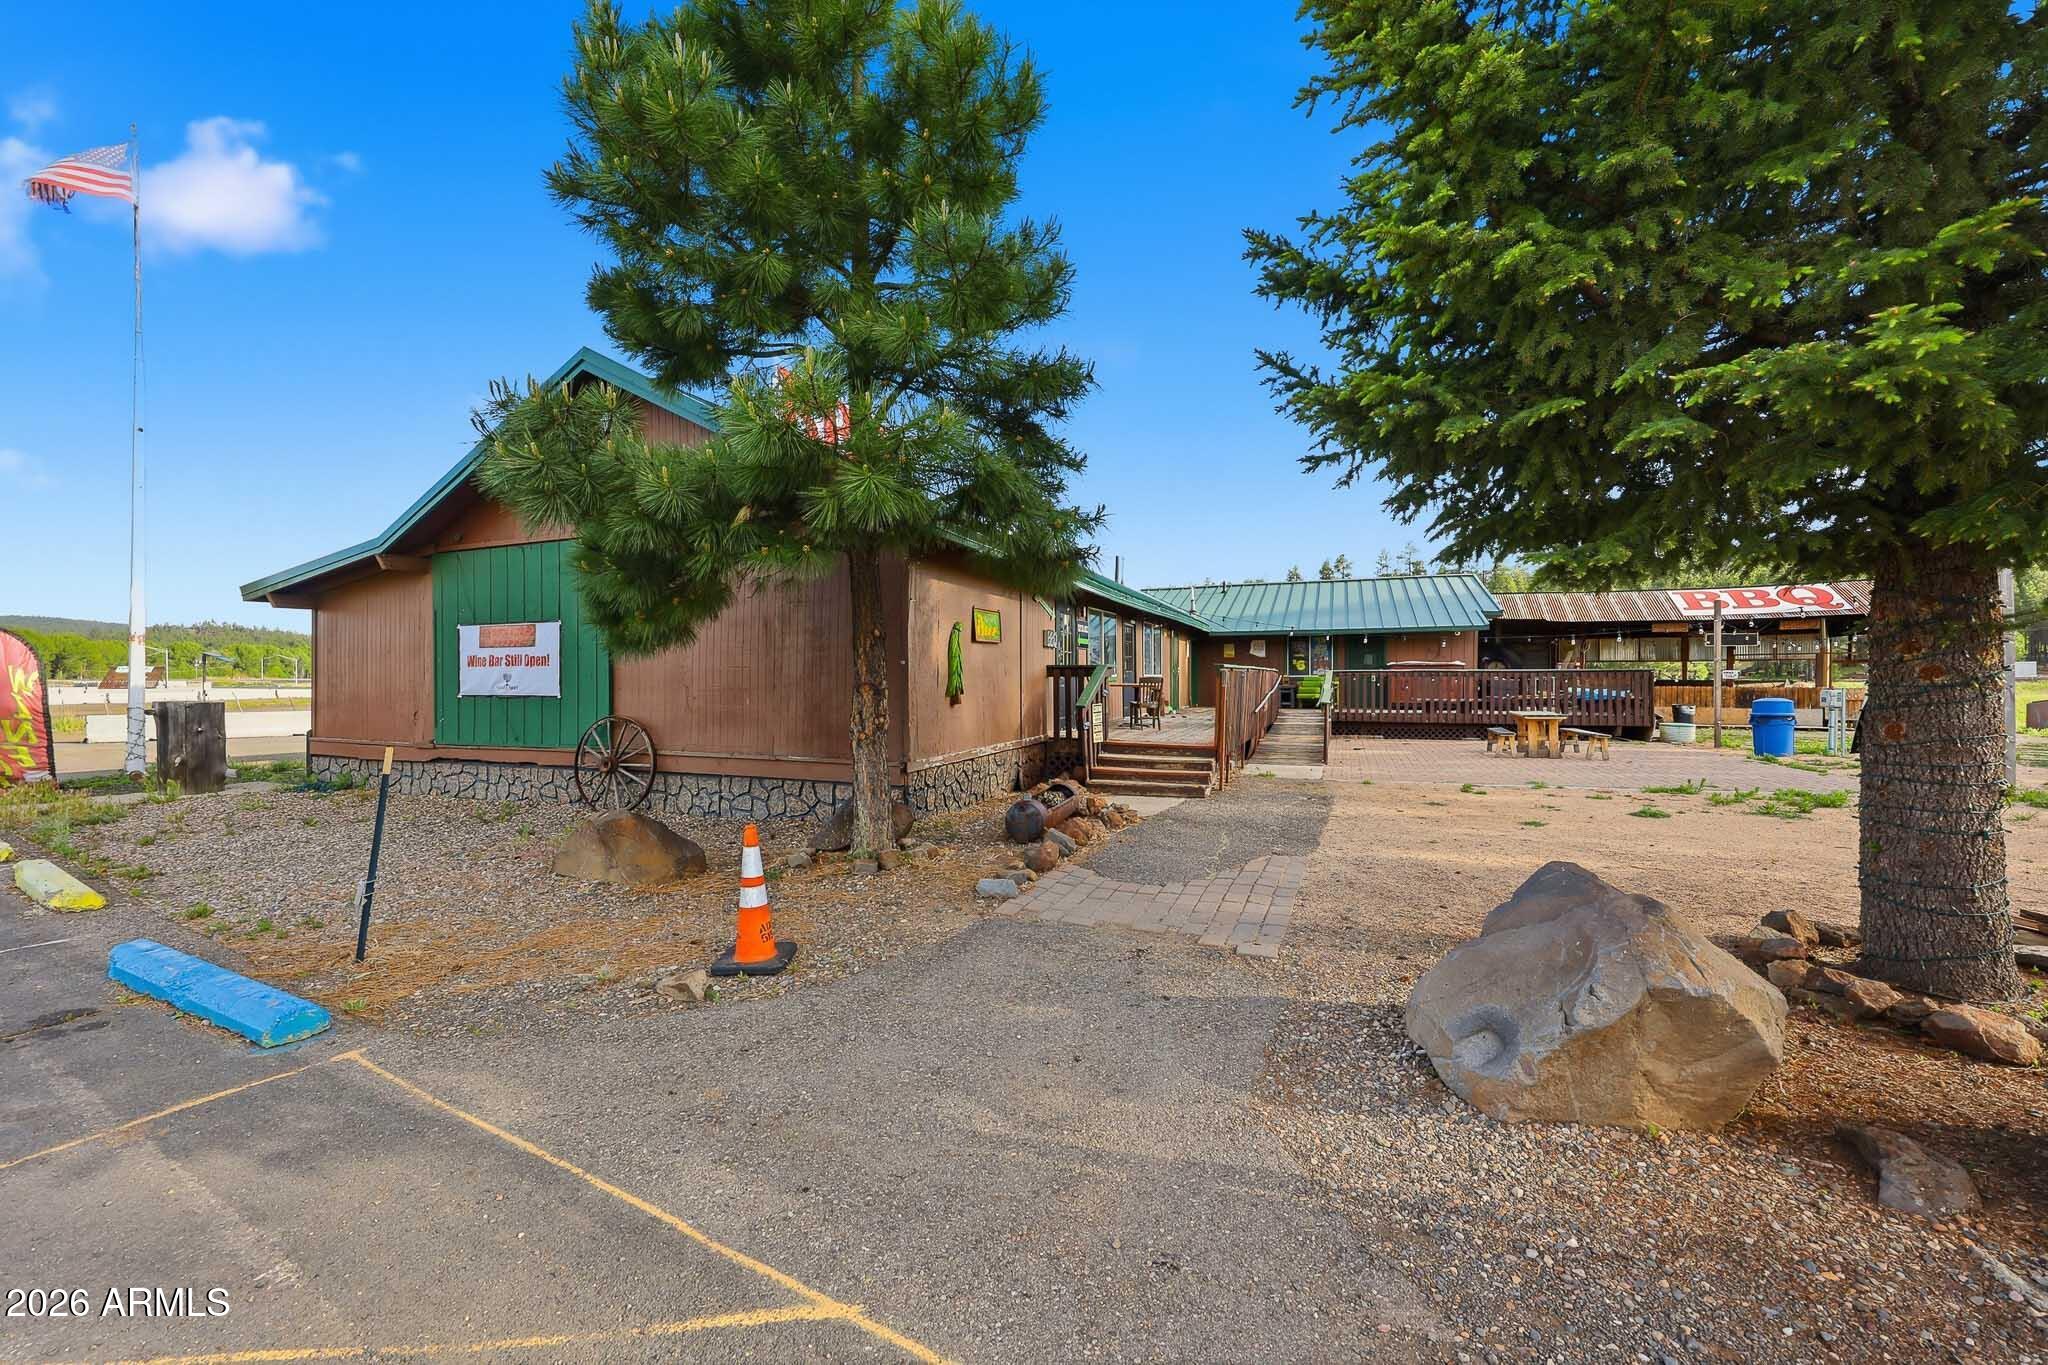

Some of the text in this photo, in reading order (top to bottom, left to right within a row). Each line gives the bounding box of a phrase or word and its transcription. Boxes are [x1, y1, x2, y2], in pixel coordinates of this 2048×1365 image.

[1671, 584, 1844, 610] BBQ
[467, 653, 550, 668] Wine Bar Still Open!
